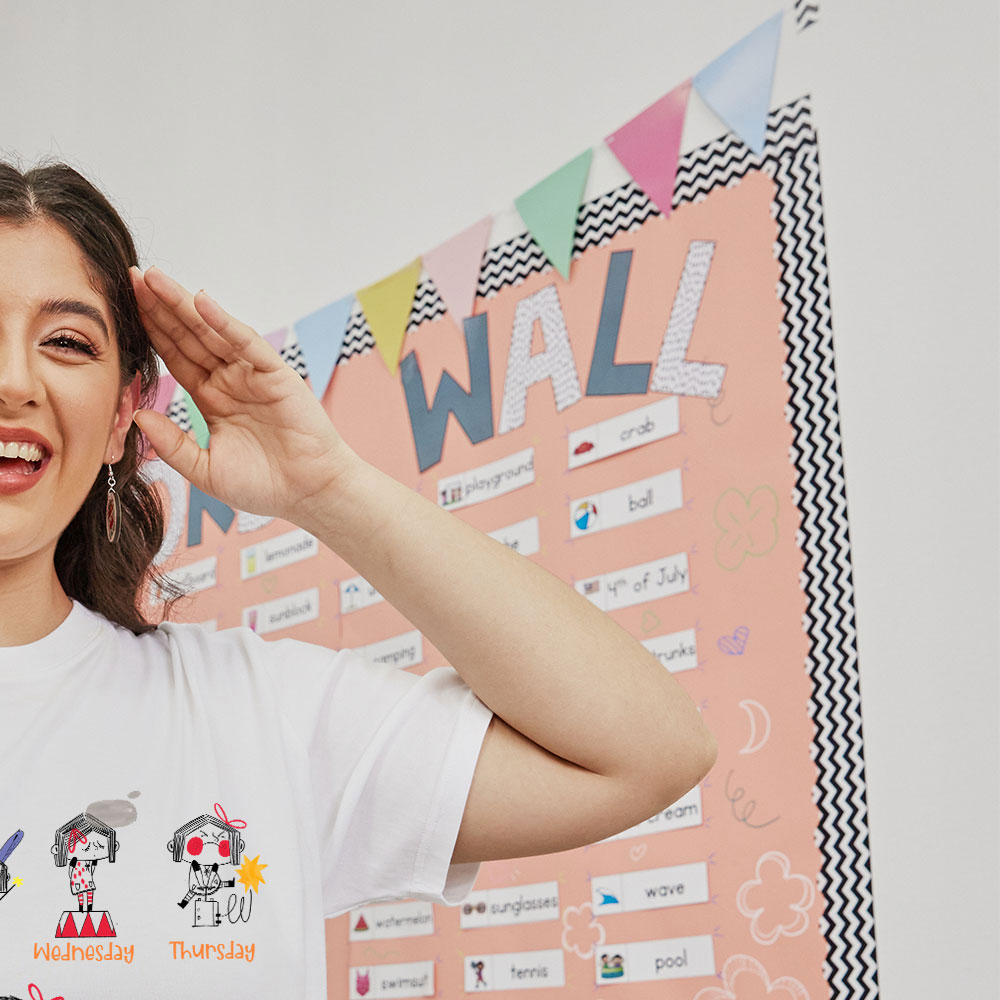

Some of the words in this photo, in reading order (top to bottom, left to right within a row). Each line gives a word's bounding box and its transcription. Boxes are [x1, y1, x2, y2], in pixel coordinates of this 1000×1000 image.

[399, 239, 728, 474] WALL
[620, 415, 655, 441] crab
[465, 454, 534, 496] playground
[628, 488, 654, 512] ball
[633, 571, 651, 593] of
[656, 565, 688, 588] July
[645, 883, 685, 898] wave
[490, 894, 558, 916] sunglasses
[33, 941, 135, 963] Wednesday
[169, 940, 256, 963] Thursday
[655, 947, 688, 974] pool
[511, 963, 549, 979] tennis
